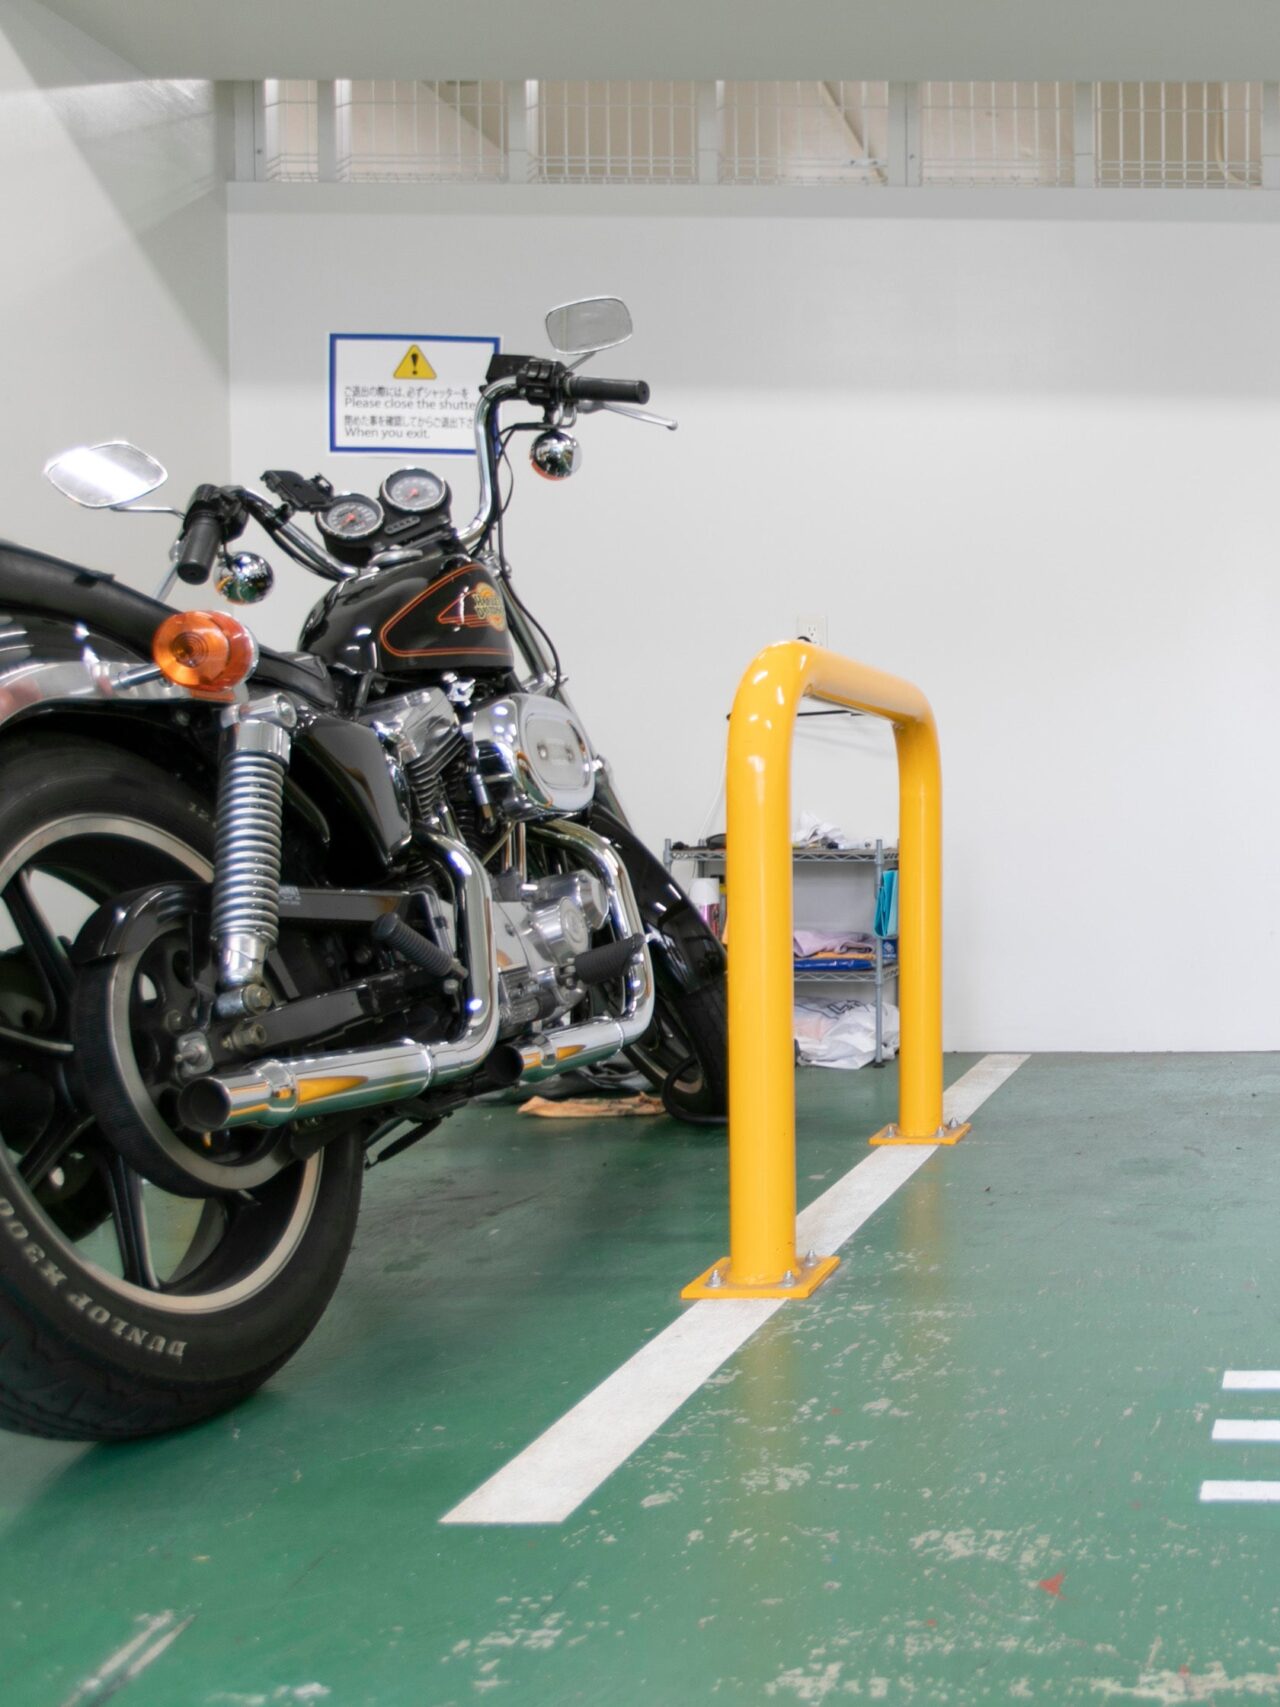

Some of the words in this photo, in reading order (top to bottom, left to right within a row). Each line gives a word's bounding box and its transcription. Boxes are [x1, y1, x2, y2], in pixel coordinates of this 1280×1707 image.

[345, 398, 381, 409] Please
[384, 399, 414, 409] close
[417, 399, 436, 410] the
[439, 400, 475, 410] shutte
[345, 416, 473, 429] 閉めた事を確認してからご退出下さ
[345, 427, 378, 438] When
[381, 430, 403, 441] you
[406, 428, 430, 439] exit.
[67, 1293, 188, 1358] DUNLOP
